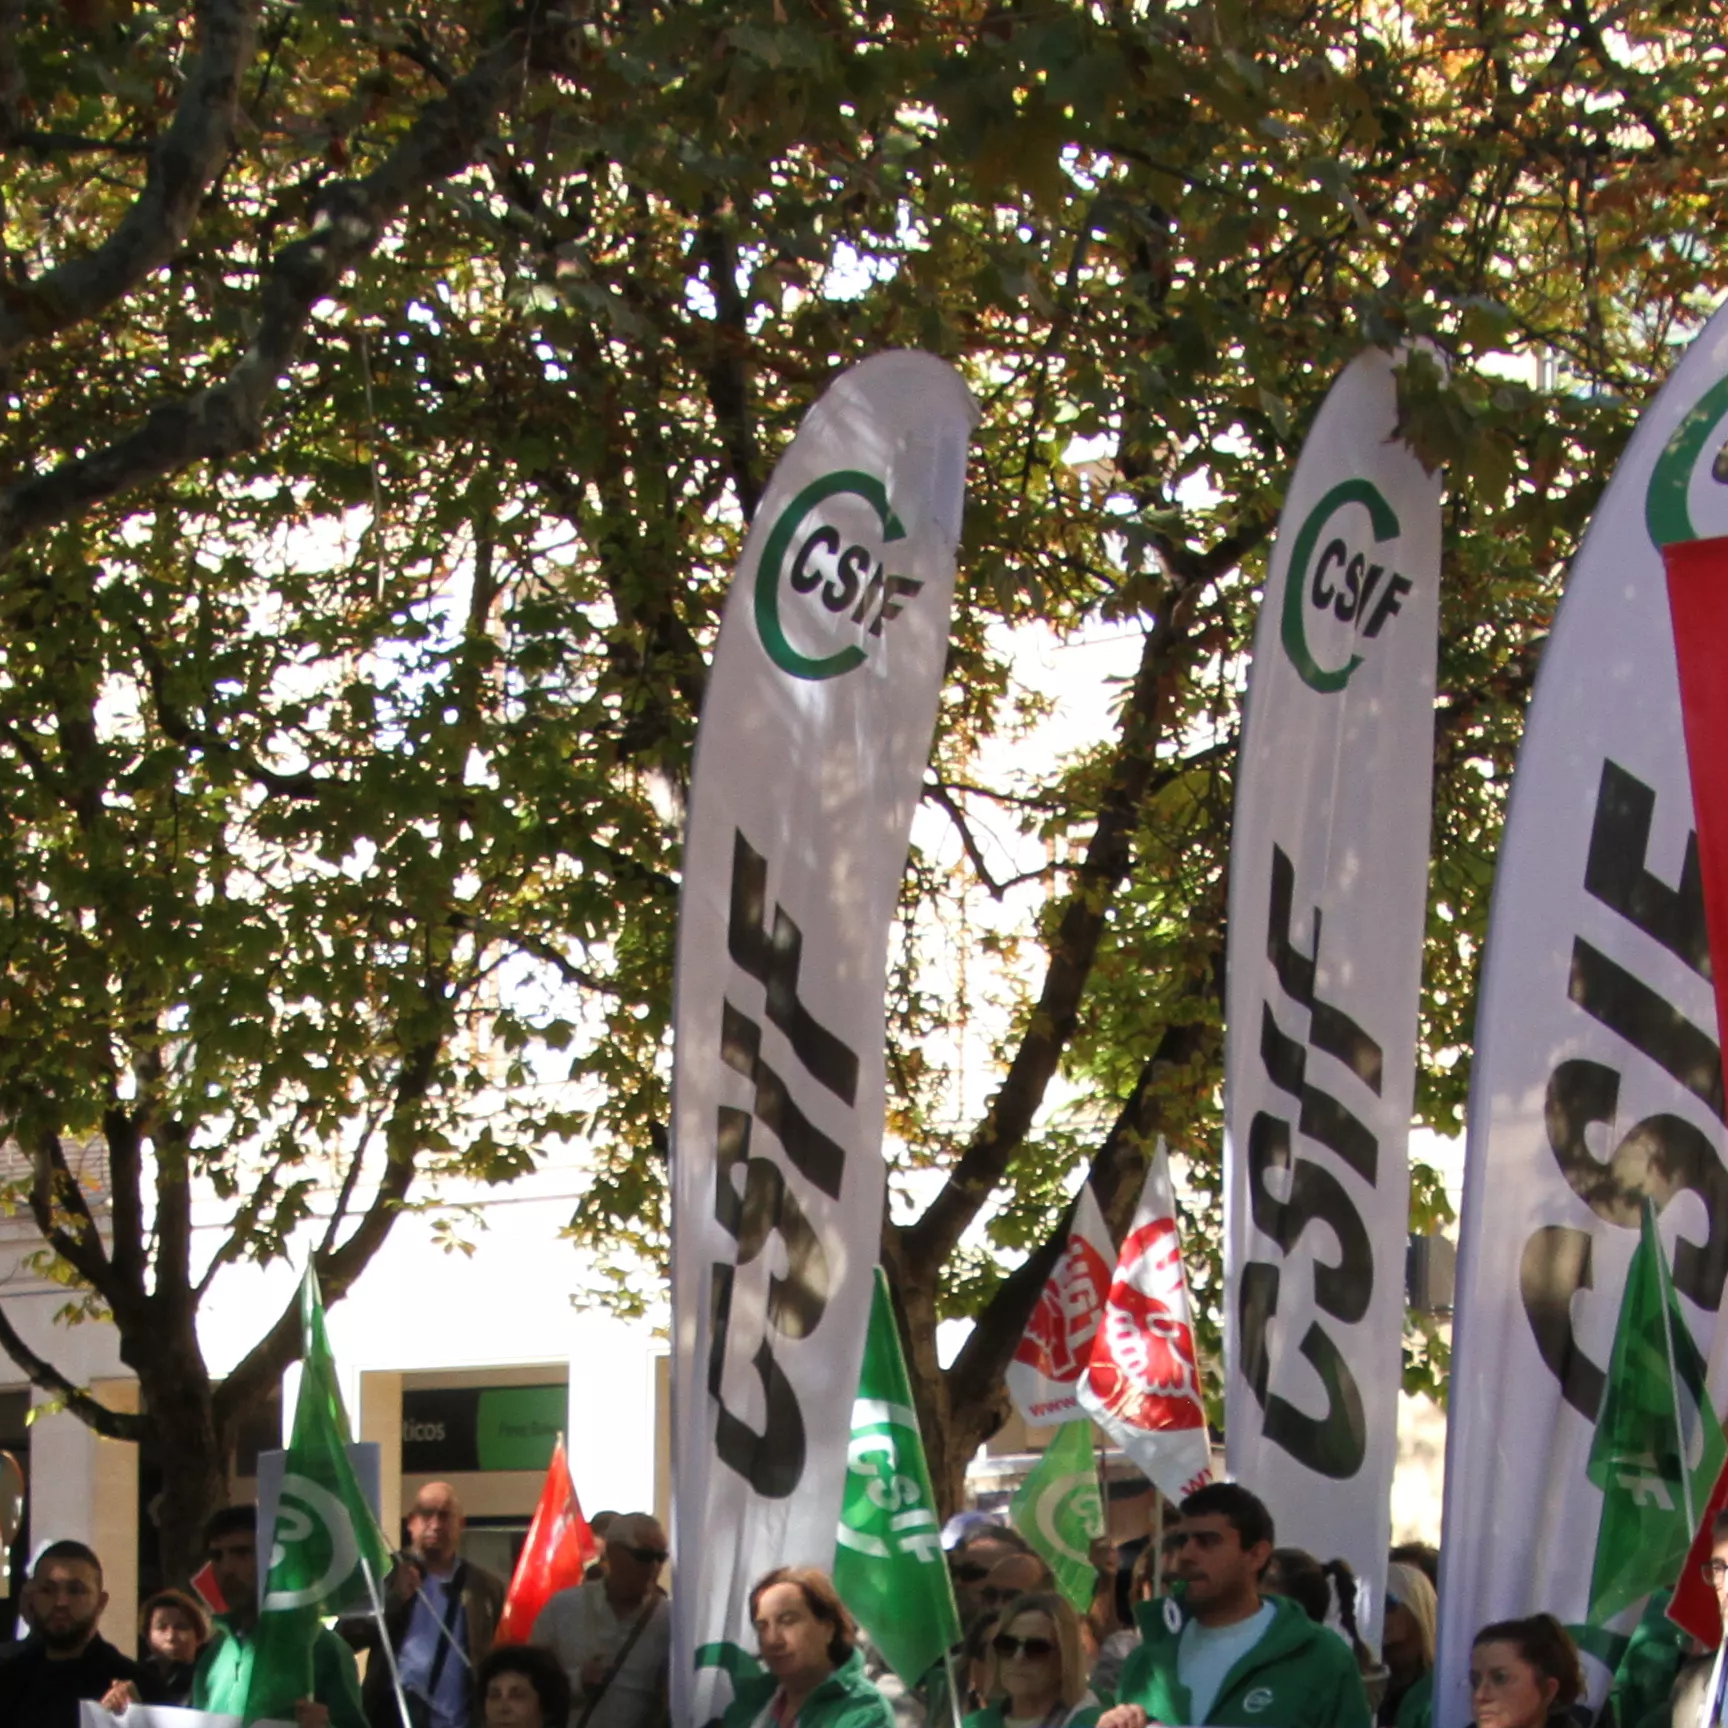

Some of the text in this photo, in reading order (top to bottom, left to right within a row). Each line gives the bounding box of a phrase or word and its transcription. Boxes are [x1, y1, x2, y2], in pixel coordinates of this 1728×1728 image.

[790, 524, 924, 638] CSIF
[1310, 538, 1414, 640] CSIF
[709, 825, 859, 1500] CSIF
[1238, 841, 1384, 1480] CSIF
[847, 1435, 942, 1562] CSIF
